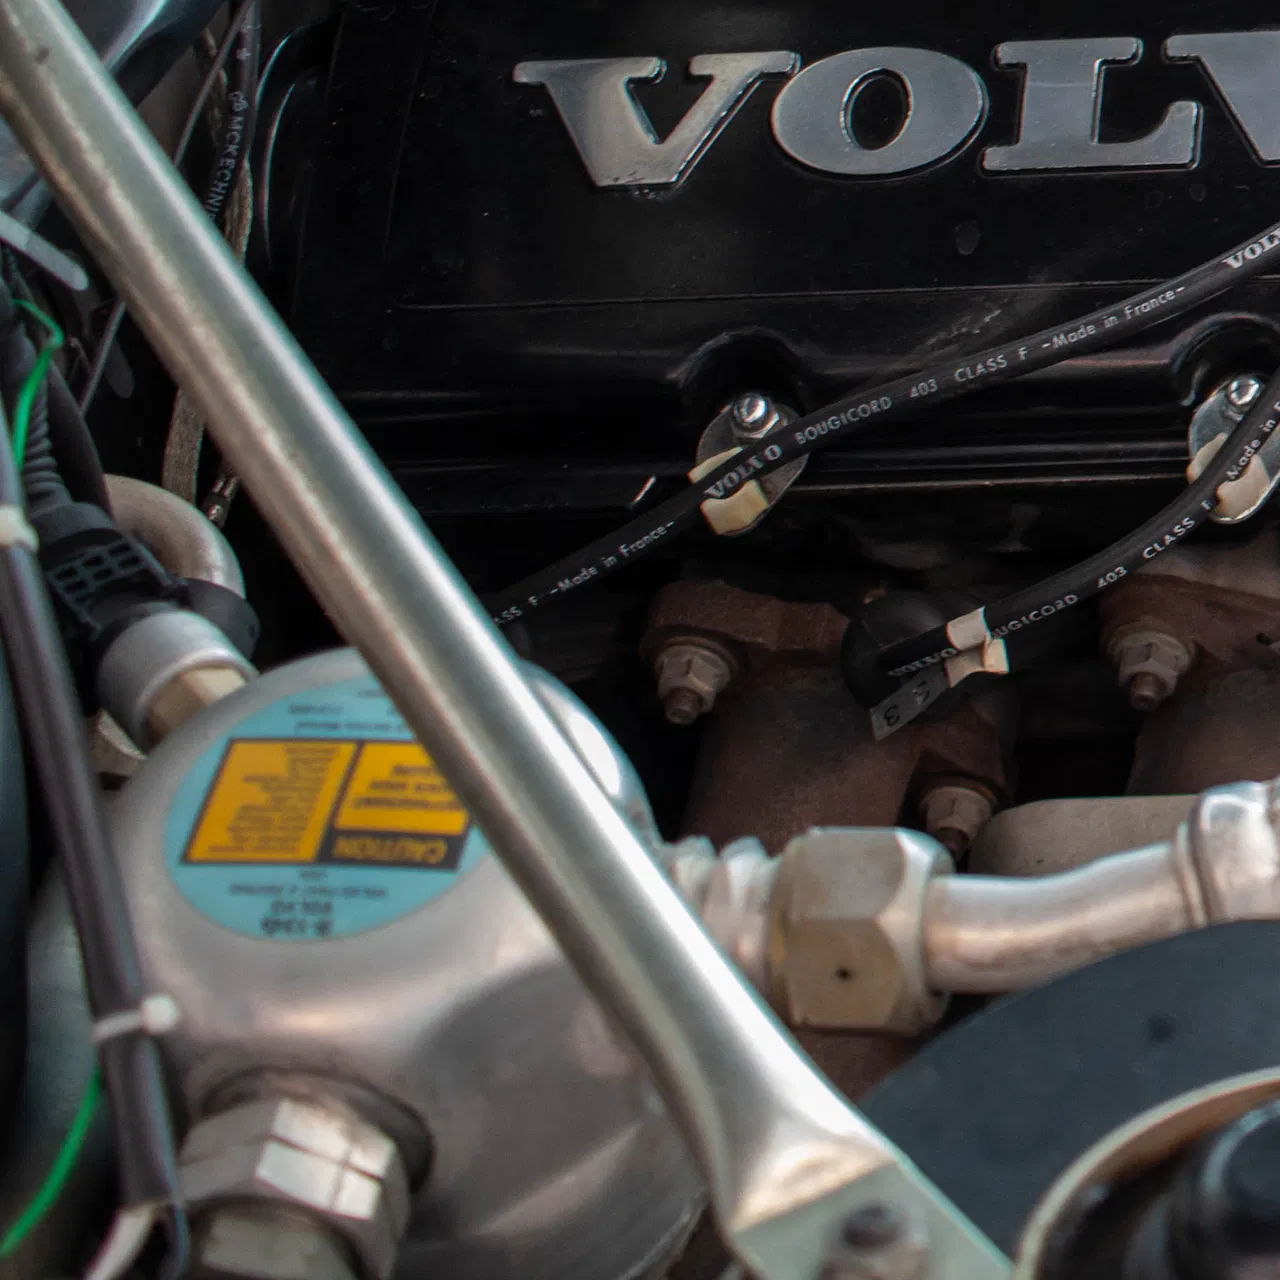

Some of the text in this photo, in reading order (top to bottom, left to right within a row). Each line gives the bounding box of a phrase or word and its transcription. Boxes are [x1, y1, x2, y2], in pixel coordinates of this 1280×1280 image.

[795, 395, 893, 447] BOUGICORD
[909, 377, 939, 400] 403
[953, 353, 1009, 385] CLASS
[1017, 345, 1029, 363] F
[1103, 314, 1119, 330] in
[1123, 285, 1187, 322] France-
[1096, 565, 1129, 590] 403
[1141, 516, 1196, 561] CLASS
[1259, 418, 1277, 434] in
[601, 555, 618, 569] in
[331, 836, 448, 864] CAUTION
